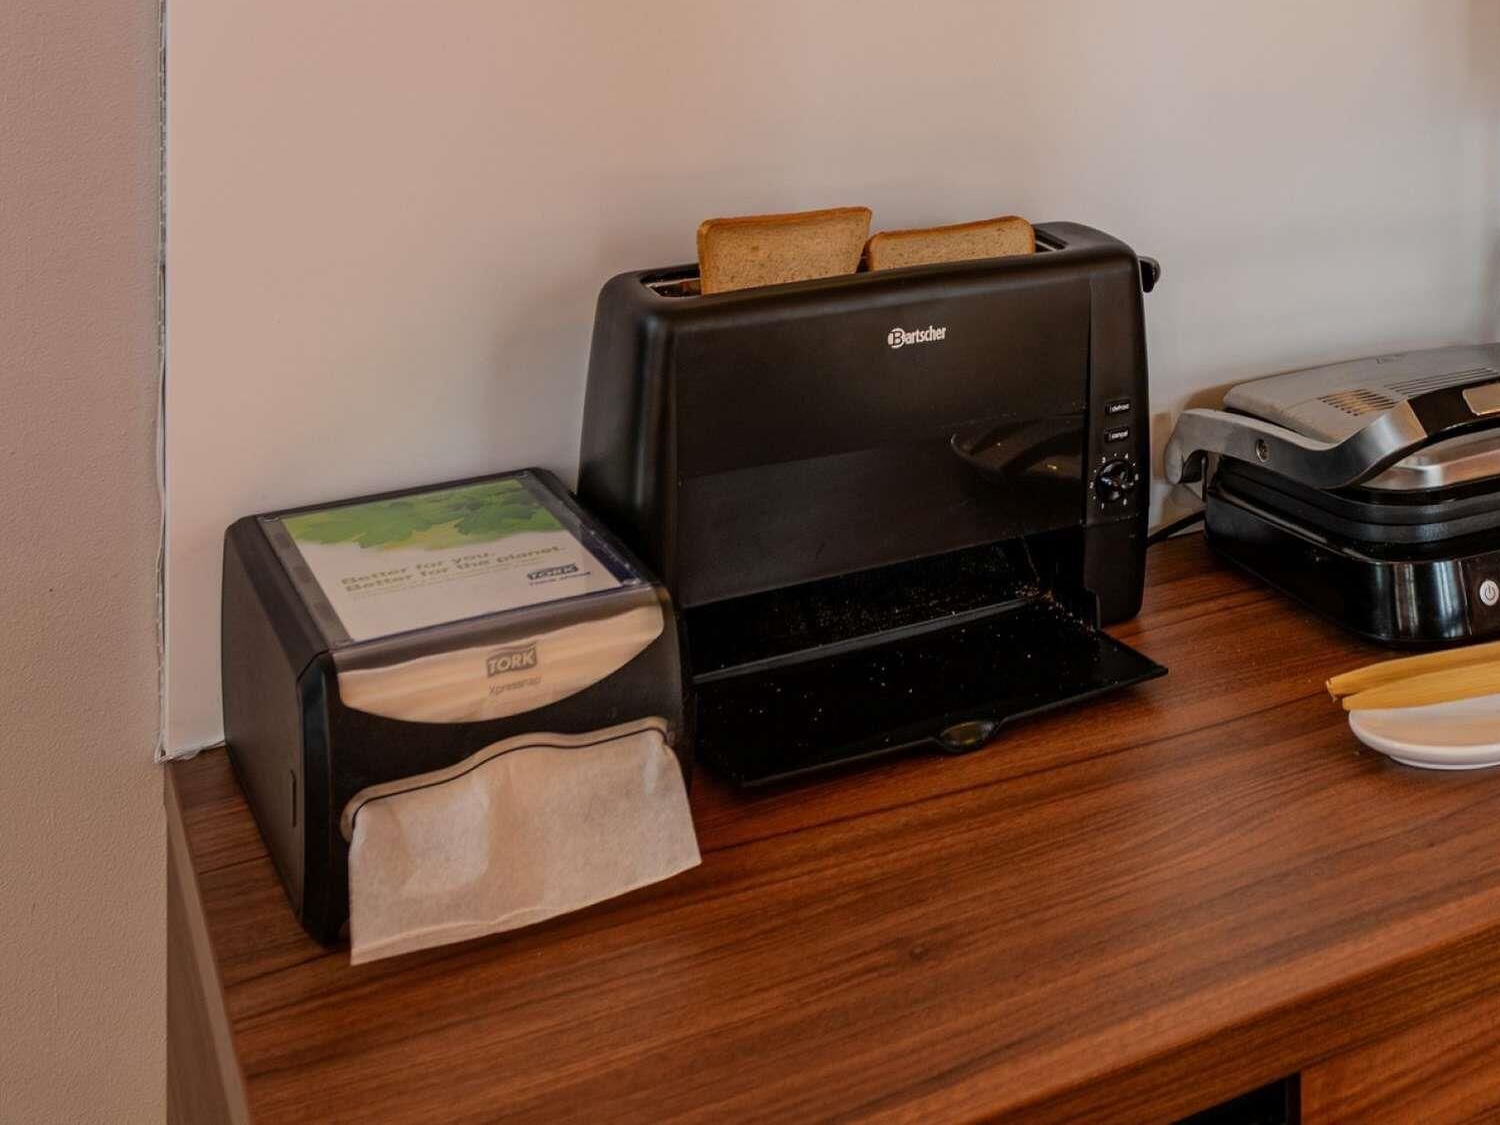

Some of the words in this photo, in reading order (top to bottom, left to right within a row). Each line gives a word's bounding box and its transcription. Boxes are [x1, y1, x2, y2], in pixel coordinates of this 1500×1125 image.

[888, 325, 947, 349] Bartscher
[341, 567, 406, 585] Better
[416, 560, 445, 571] for
[346, 574, 412, 592] Better
[421, 566, 449, 577] for
[456, 559, 491, 571] the
[488, 649, 535, 674] TORK
